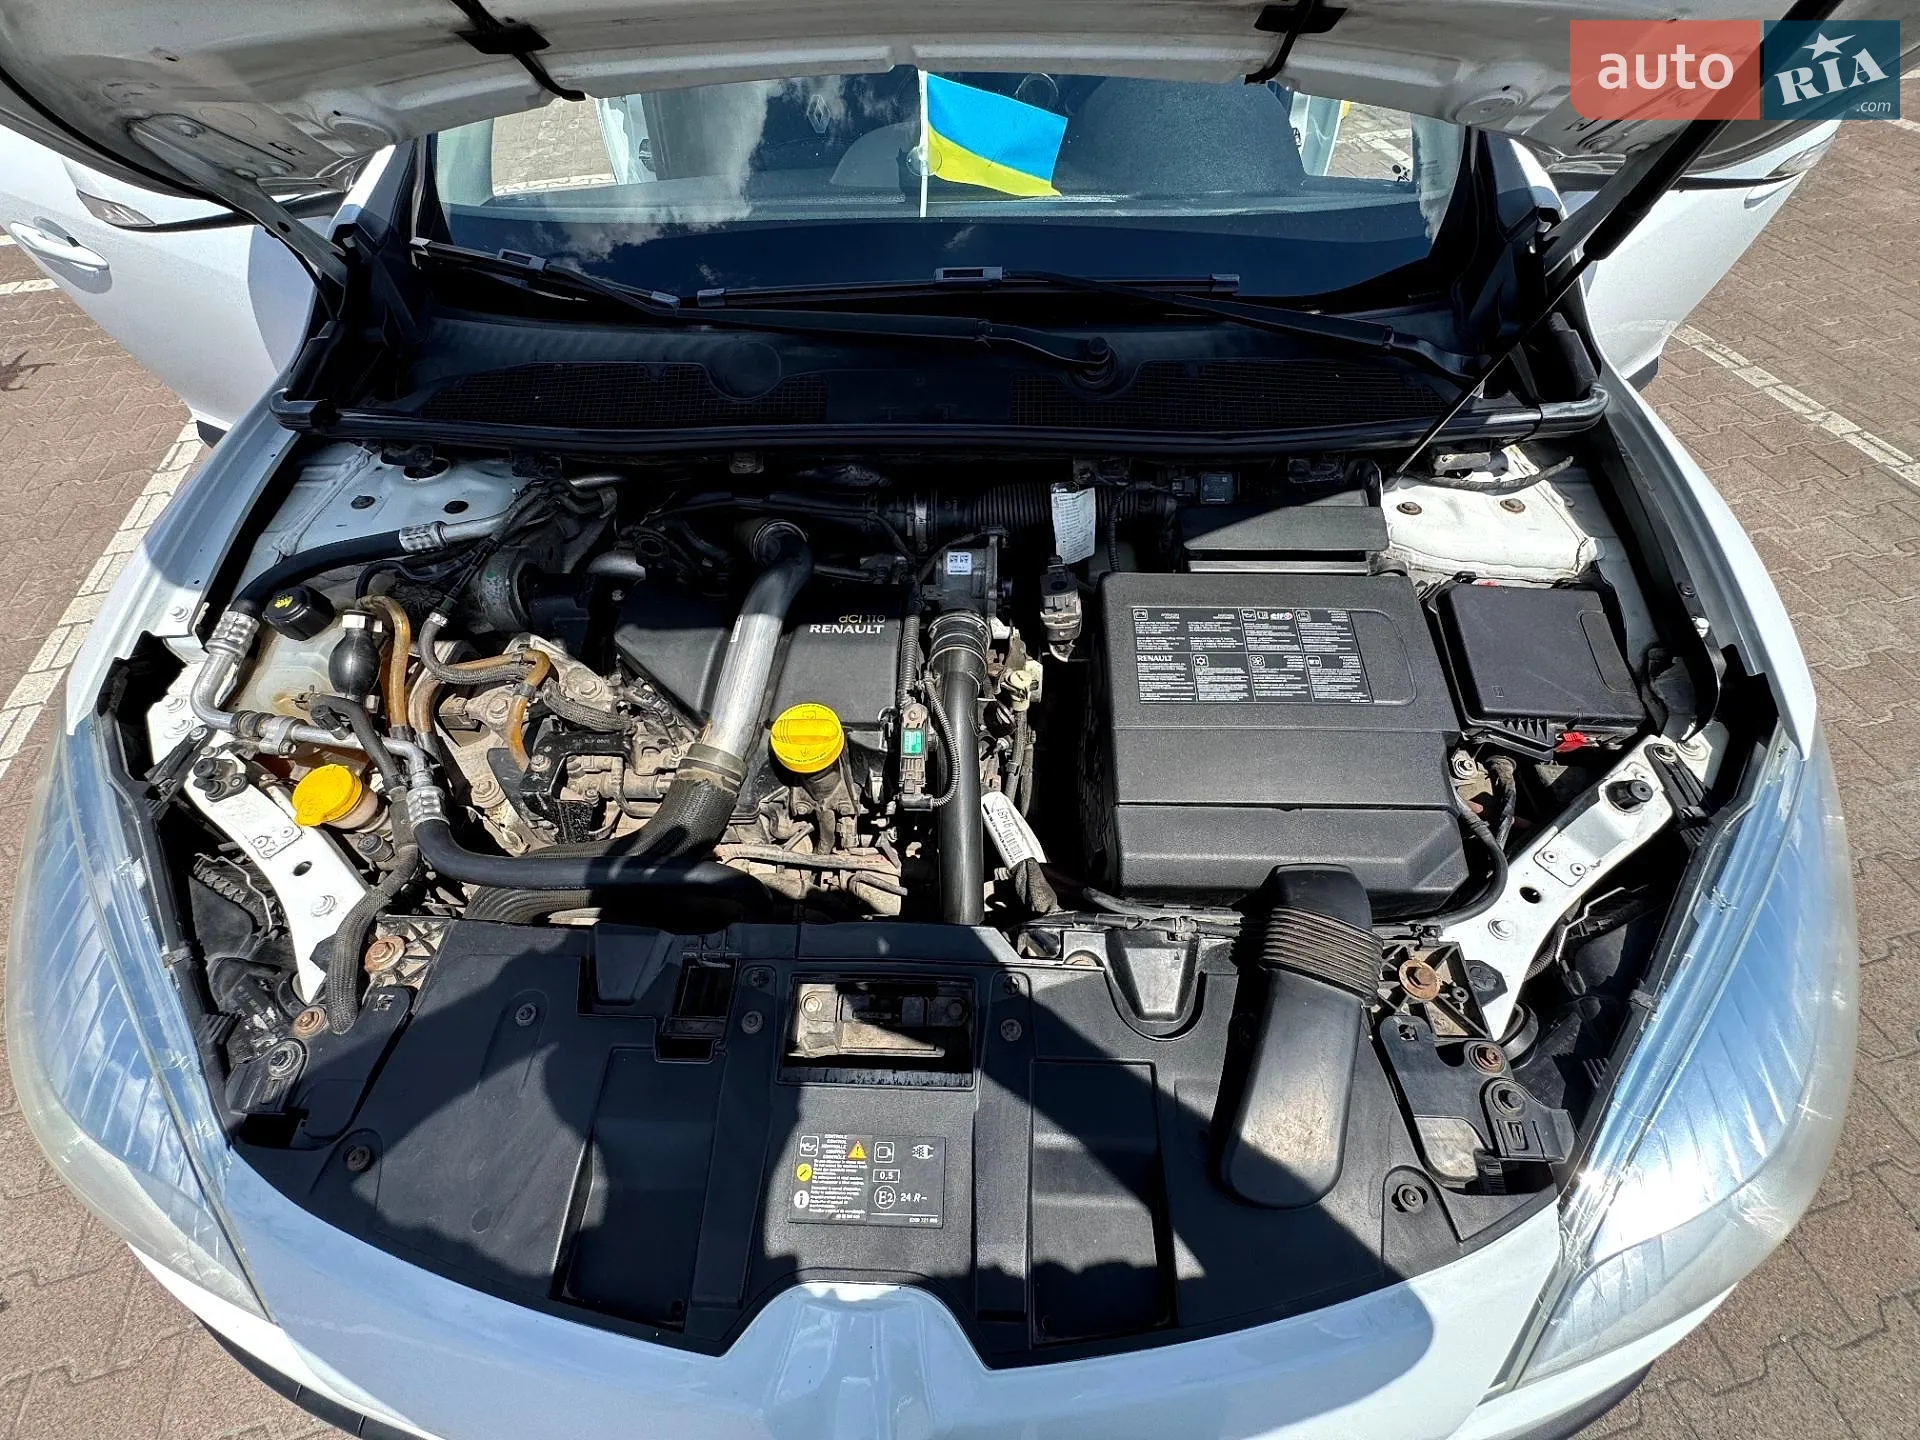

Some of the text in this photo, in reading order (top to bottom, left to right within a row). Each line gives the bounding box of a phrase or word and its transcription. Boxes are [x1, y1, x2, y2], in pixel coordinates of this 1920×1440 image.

[809, 624, 885, 634] RENAULT
[879, 1171, 893, 1180] 0,5
[878, 1191, 893, 1205] E2
[900, 1192, 911, 1202] 24
